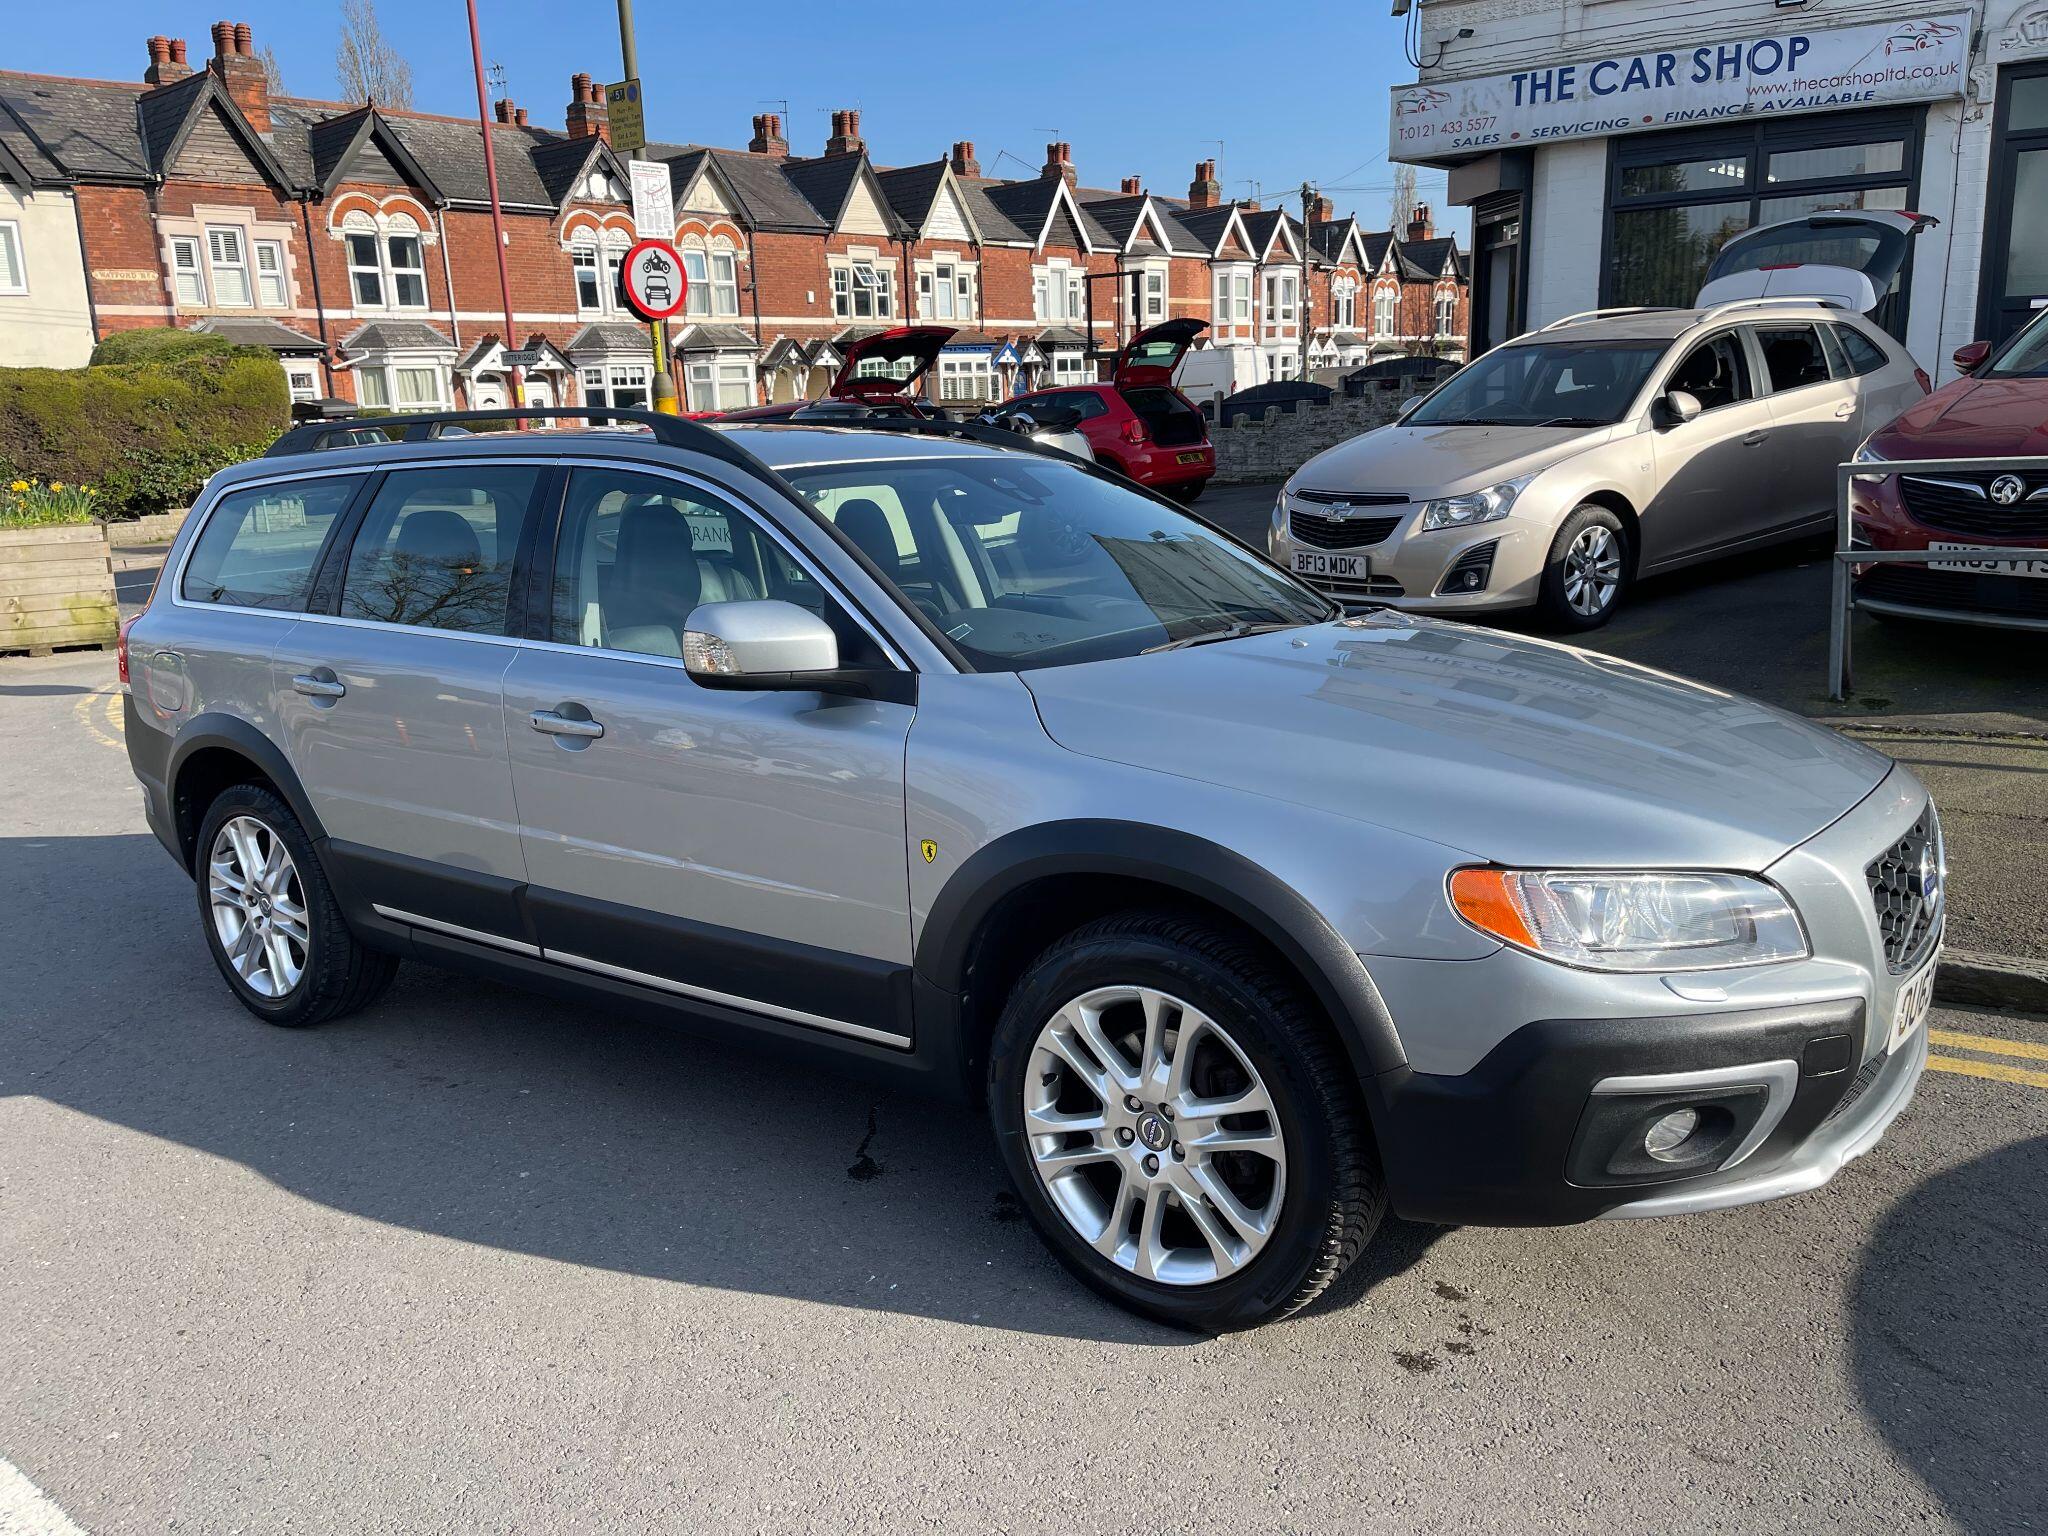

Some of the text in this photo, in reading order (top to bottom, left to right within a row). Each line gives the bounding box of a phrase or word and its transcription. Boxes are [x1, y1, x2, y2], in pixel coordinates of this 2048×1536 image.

[1511, 66, 1575, 107] THE
[1589, 53, 1676, 96] CAR
[1690, 36, 1810, 84] SHOP
[1746, 61, 1960, 97] www.thecarshopltd.co.uk
[1399, 116, 1497, 141] T:0121 433 5577
[1451, 90, 1876, 148] SALES SERVICING FINANCE AVAILABLE
[1297, 553, 1357, 575] BF13 MDK
